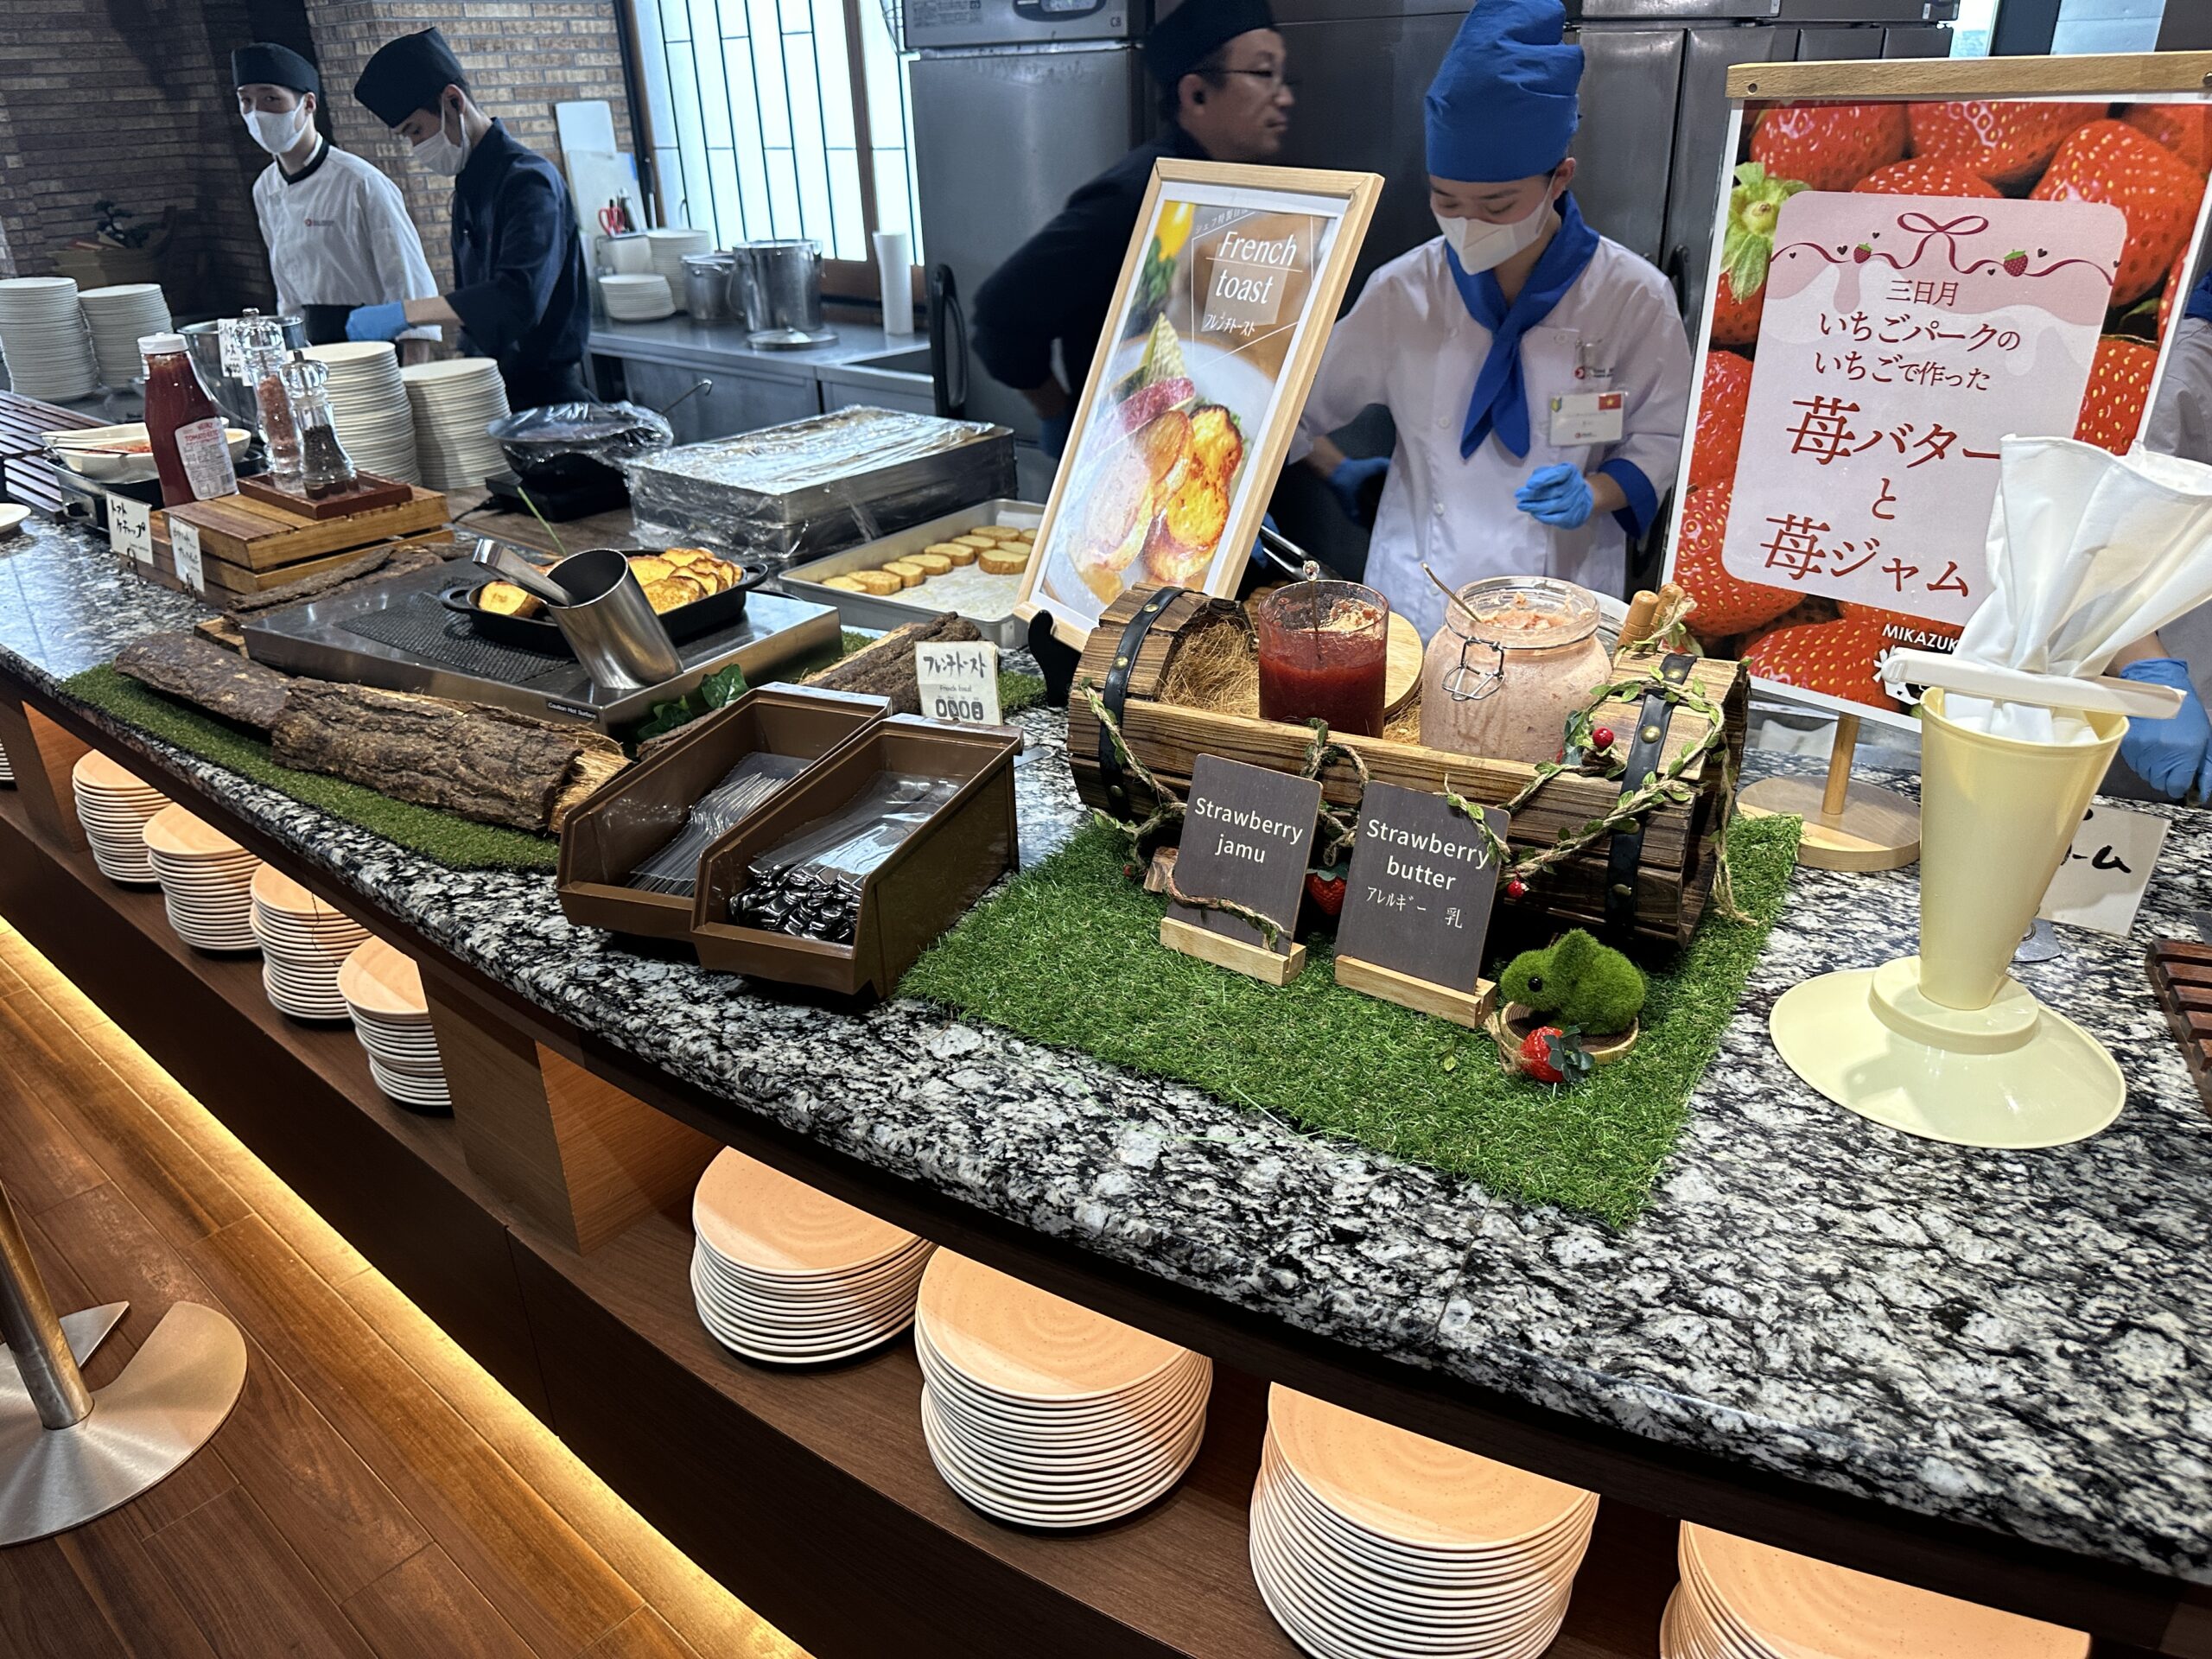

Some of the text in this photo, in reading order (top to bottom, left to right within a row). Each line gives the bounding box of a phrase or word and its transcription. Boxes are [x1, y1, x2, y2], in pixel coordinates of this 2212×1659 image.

[1219, 231, 1298, 266] French
[1215, 269, 1273, 304] toast
[1885, 279, 1960, 307] 三日月
[1204, 313, 1255, 337] フレンチトースト
[1819, 311, 2021, 352] いちごパークの
[1815, 350, 1991, 391] いちごで作った
[1786, 395, 2001, 468] 苺バター
[1871, 477, 1897, 519] と
[1759, 513, 1969, 597] 苺ジャム
[548, 702, 597, 720] Caution Hot Surface
[1194, 798, 1303, 845] Strawberry
[1214, 833, 1266, 864] jamu
[1366, 818, 1490, 870] Strawberry
[2061, 844, 2132, 874] ーム
[1386, 855, 1457, 890] butter
[1444, 906, 1463, 929] 乳
